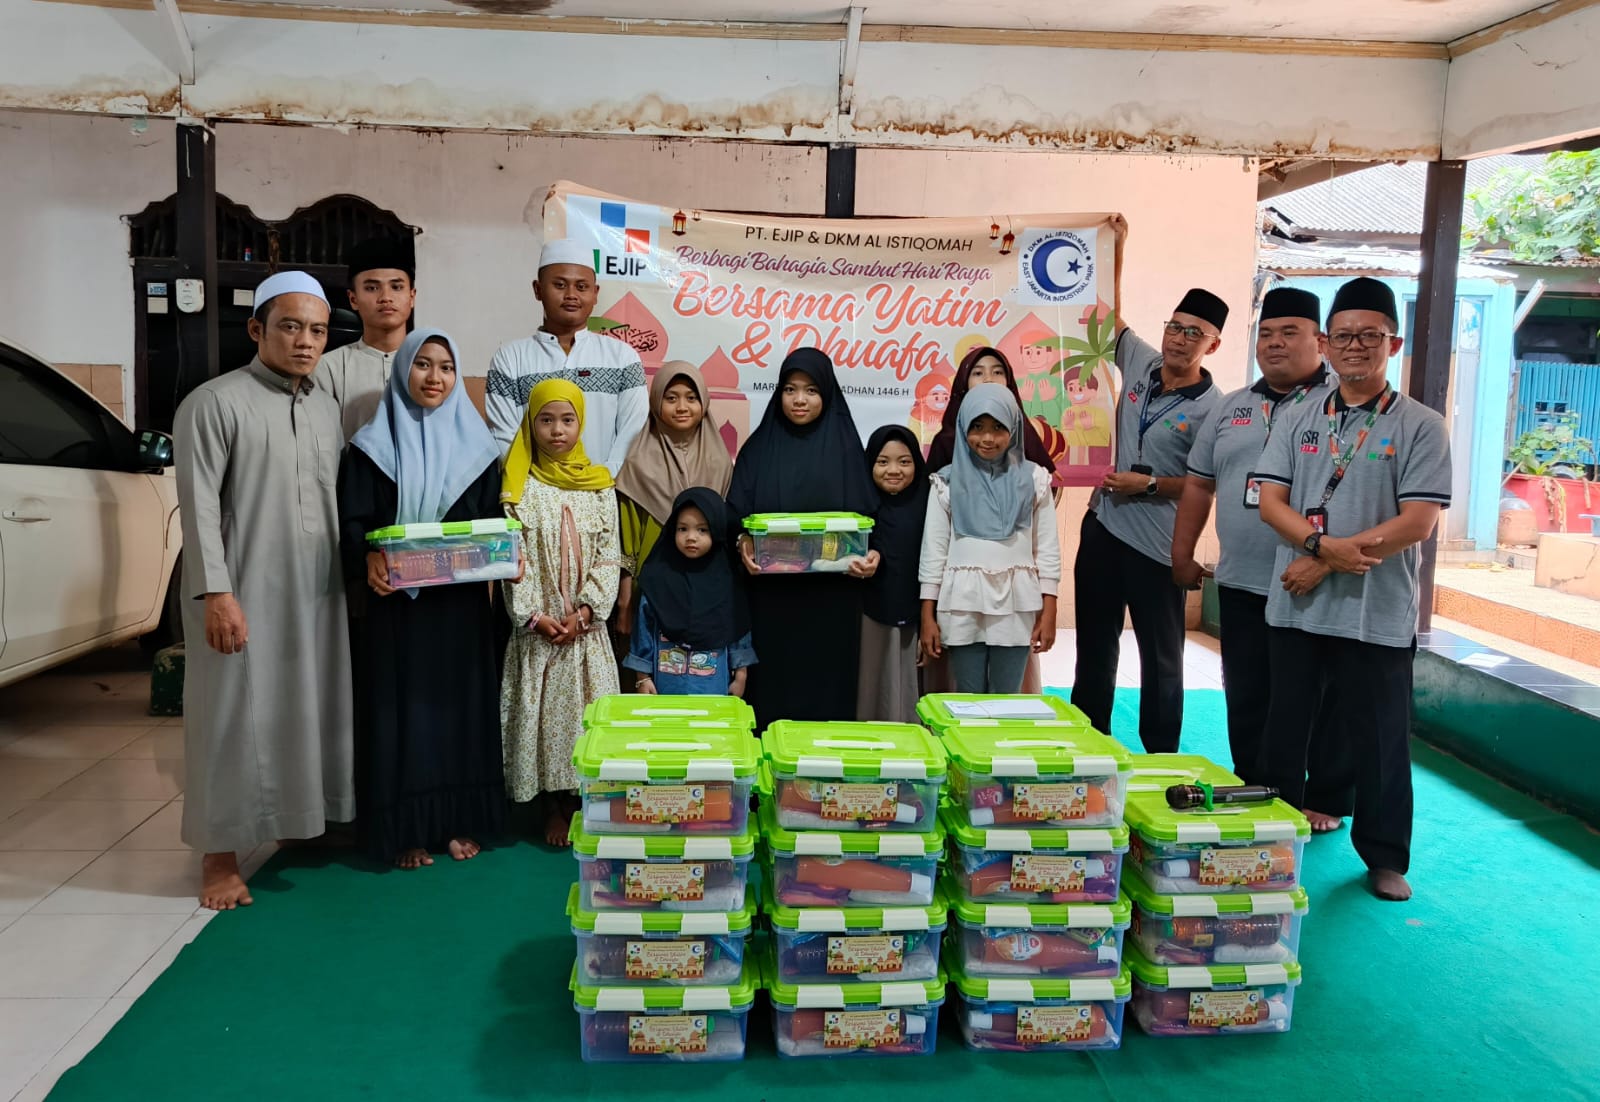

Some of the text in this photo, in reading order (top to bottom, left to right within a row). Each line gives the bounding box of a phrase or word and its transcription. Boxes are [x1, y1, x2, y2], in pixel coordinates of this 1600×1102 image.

[745, 226, 973, 252] PT. EJIP & DKM AL ISTIQOMAH
[605, 255, 647, 277] EJIP
[676, 245, 992, 286] Berbagi Bahagia Sambut Hari Raya
[1022, 262, 1031, 279] EAST
[1027, 280, 1051, 302] JAKARTA
[1052, 282, 1089, 302] INDUSTRIAL
[672, 270, 1007, 334] Bersama Yatim
[731, 321, 948, 382] & Dhuafa
[753, 382, 779, 391] MAR
[841, 385, 910, 396] ADHAN 1446 H
[1233, 407, 1253, 418] CSR
